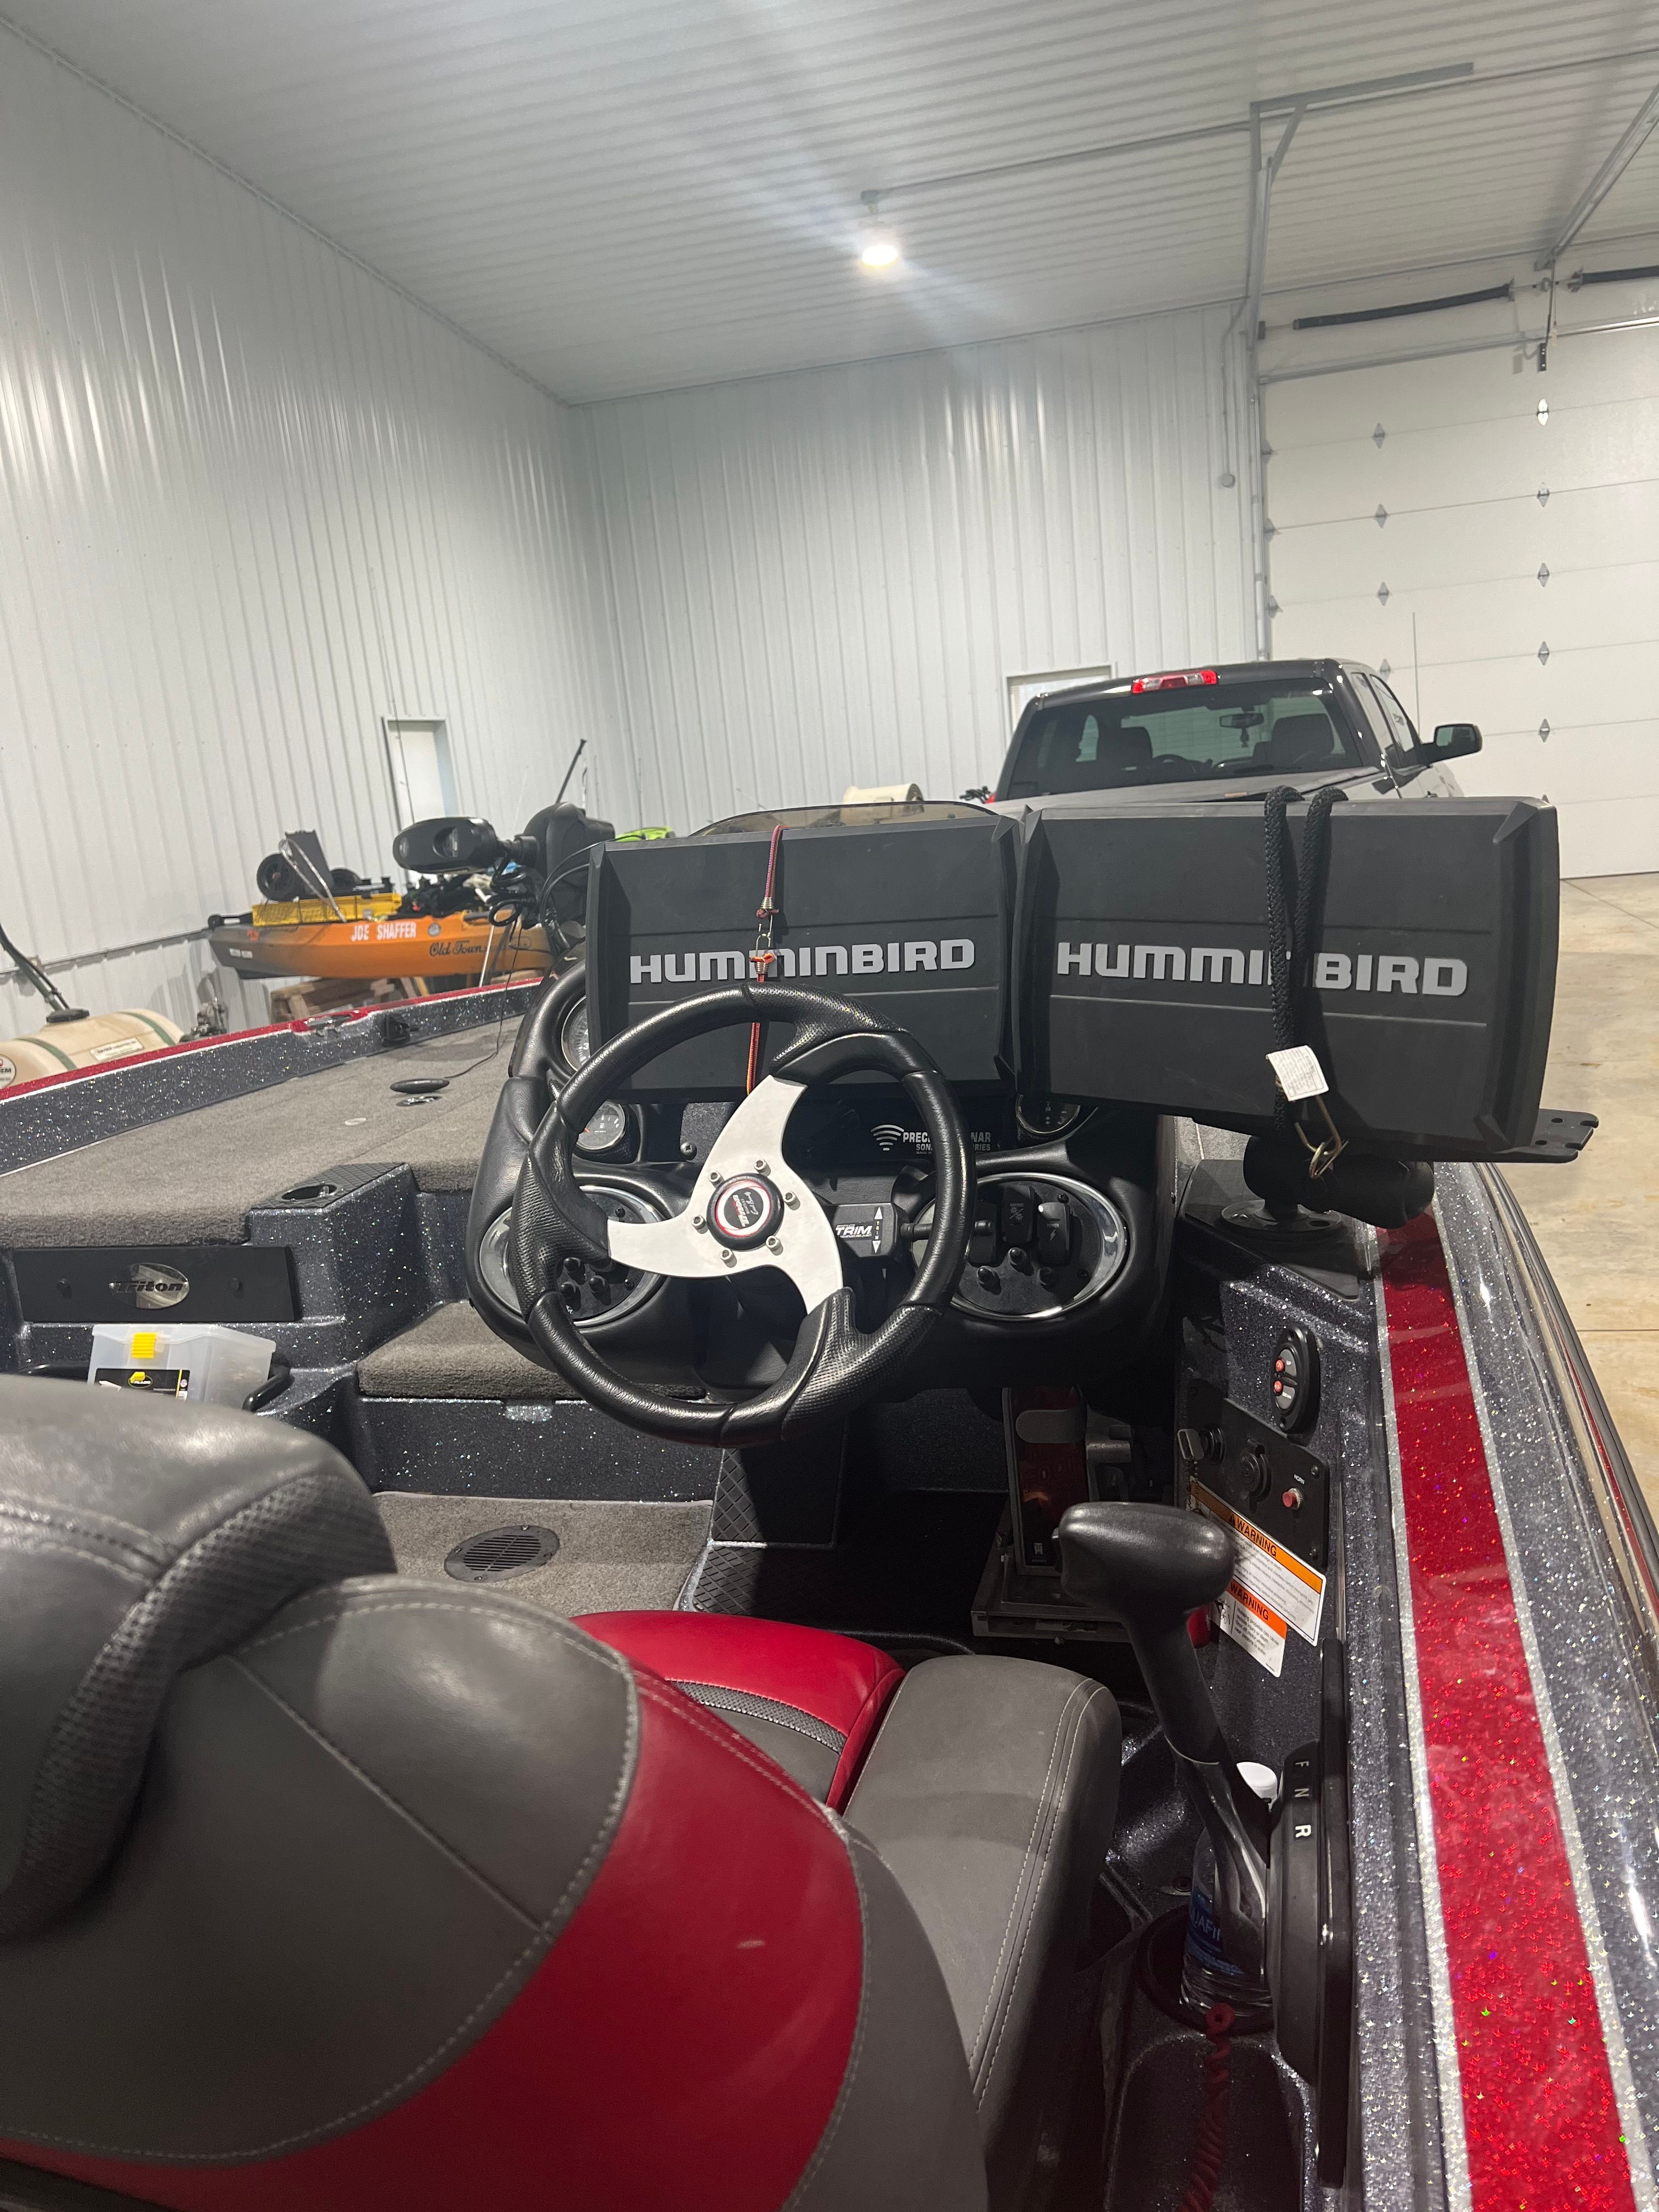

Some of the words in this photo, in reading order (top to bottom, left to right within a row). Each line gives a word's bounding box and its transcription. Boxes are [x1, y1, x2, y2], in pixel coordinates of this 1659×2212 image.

[351, 924, 369, 941] JOE
[377, 922, 416, 940] SHAFFER
[430, 943, 450, 957] Old
[454, 940, 482, 953] Town
[630, 939, 976, 983] HUMMINBIRD
[1057, 942, 1468, 996] HUMMIBIRD
[971, 1132, 991, 1143] NAR
[835, 1225, 872, 1235] TRIM
[1237, 1518, 1277, 1558] WARNING
[1231, 1582, 1269, 1621] WARNING
[1295, 1788, 1309, 1798] N
[1295, 1824, 1311, 1838] R
